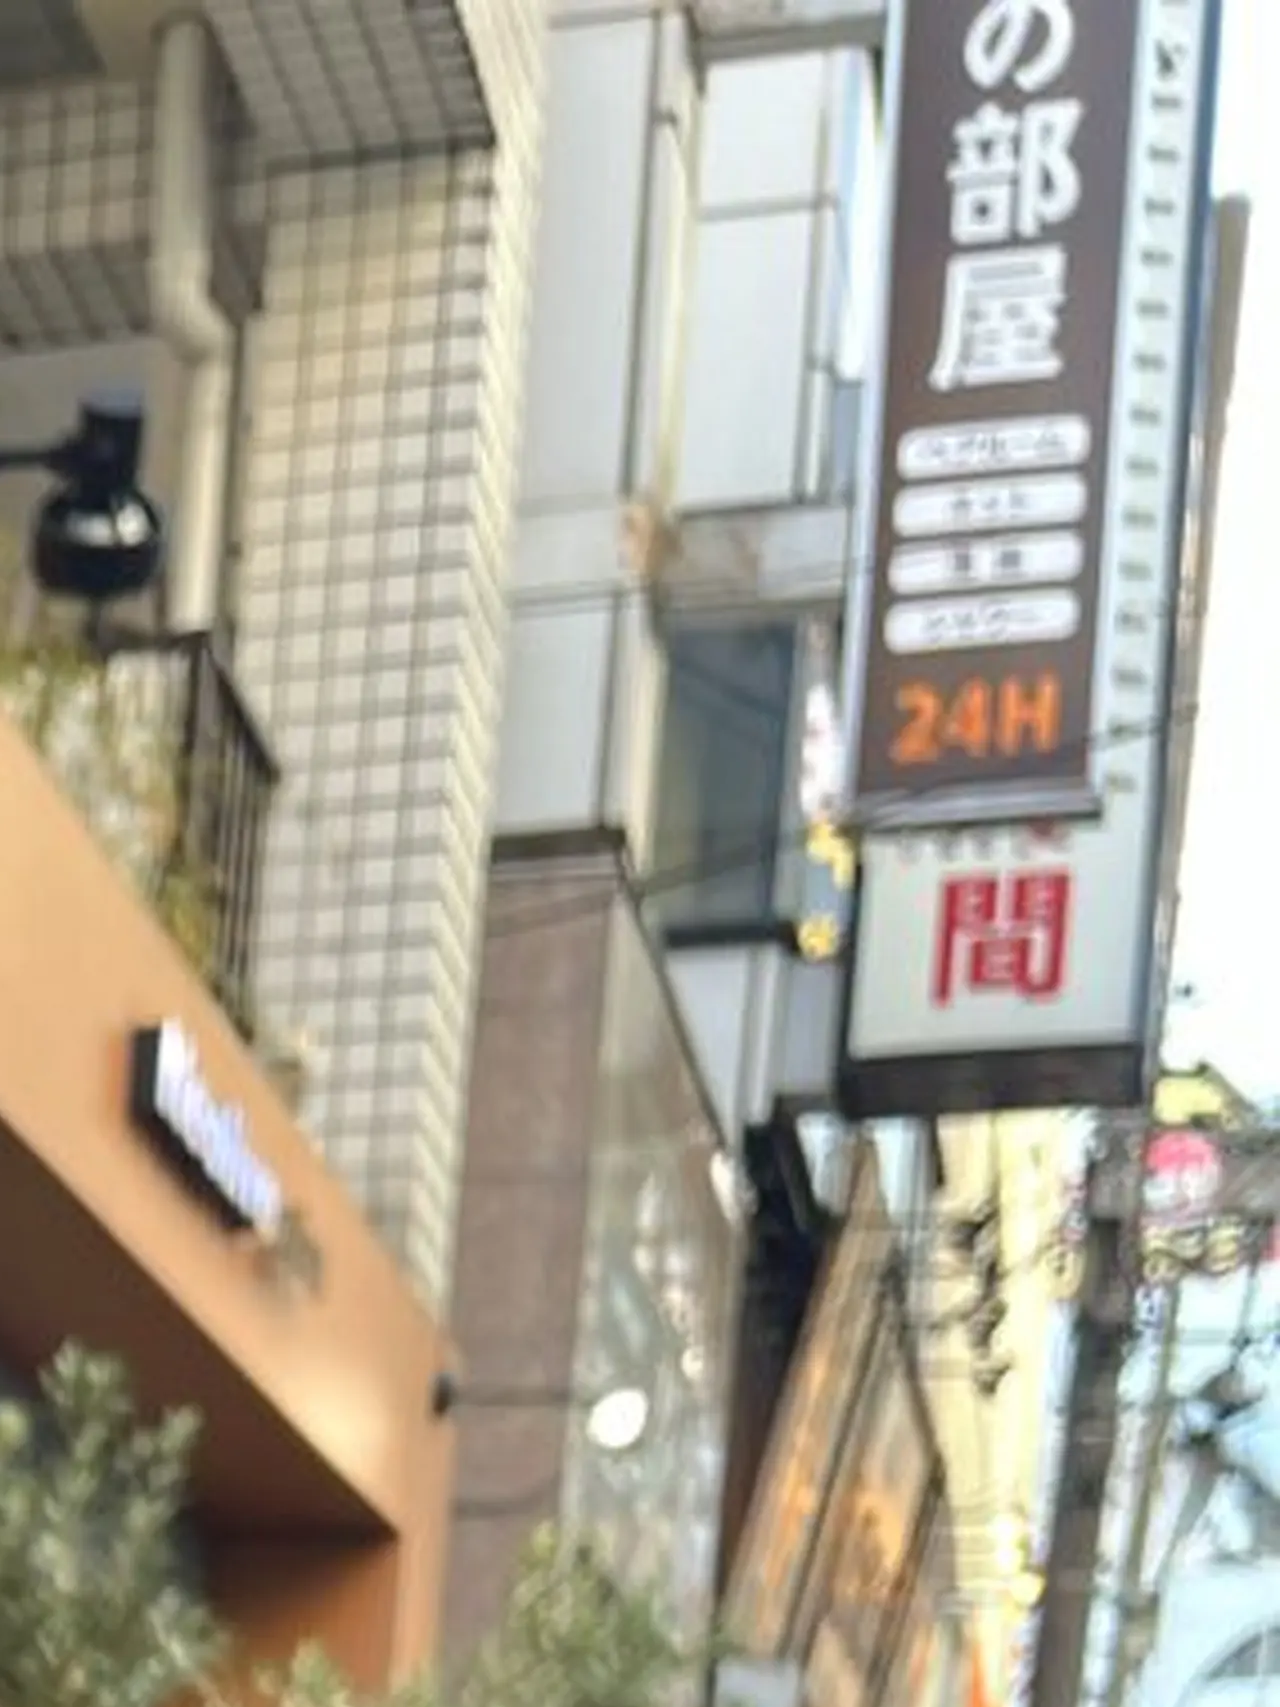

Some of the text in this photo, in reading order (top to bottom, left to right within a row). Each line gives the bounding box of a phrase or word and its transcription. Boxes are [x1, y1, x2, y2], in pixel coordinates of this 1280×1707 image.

[928, 0, 1085, 391] の部屋
[889, 670, 1064, 766] 24H
